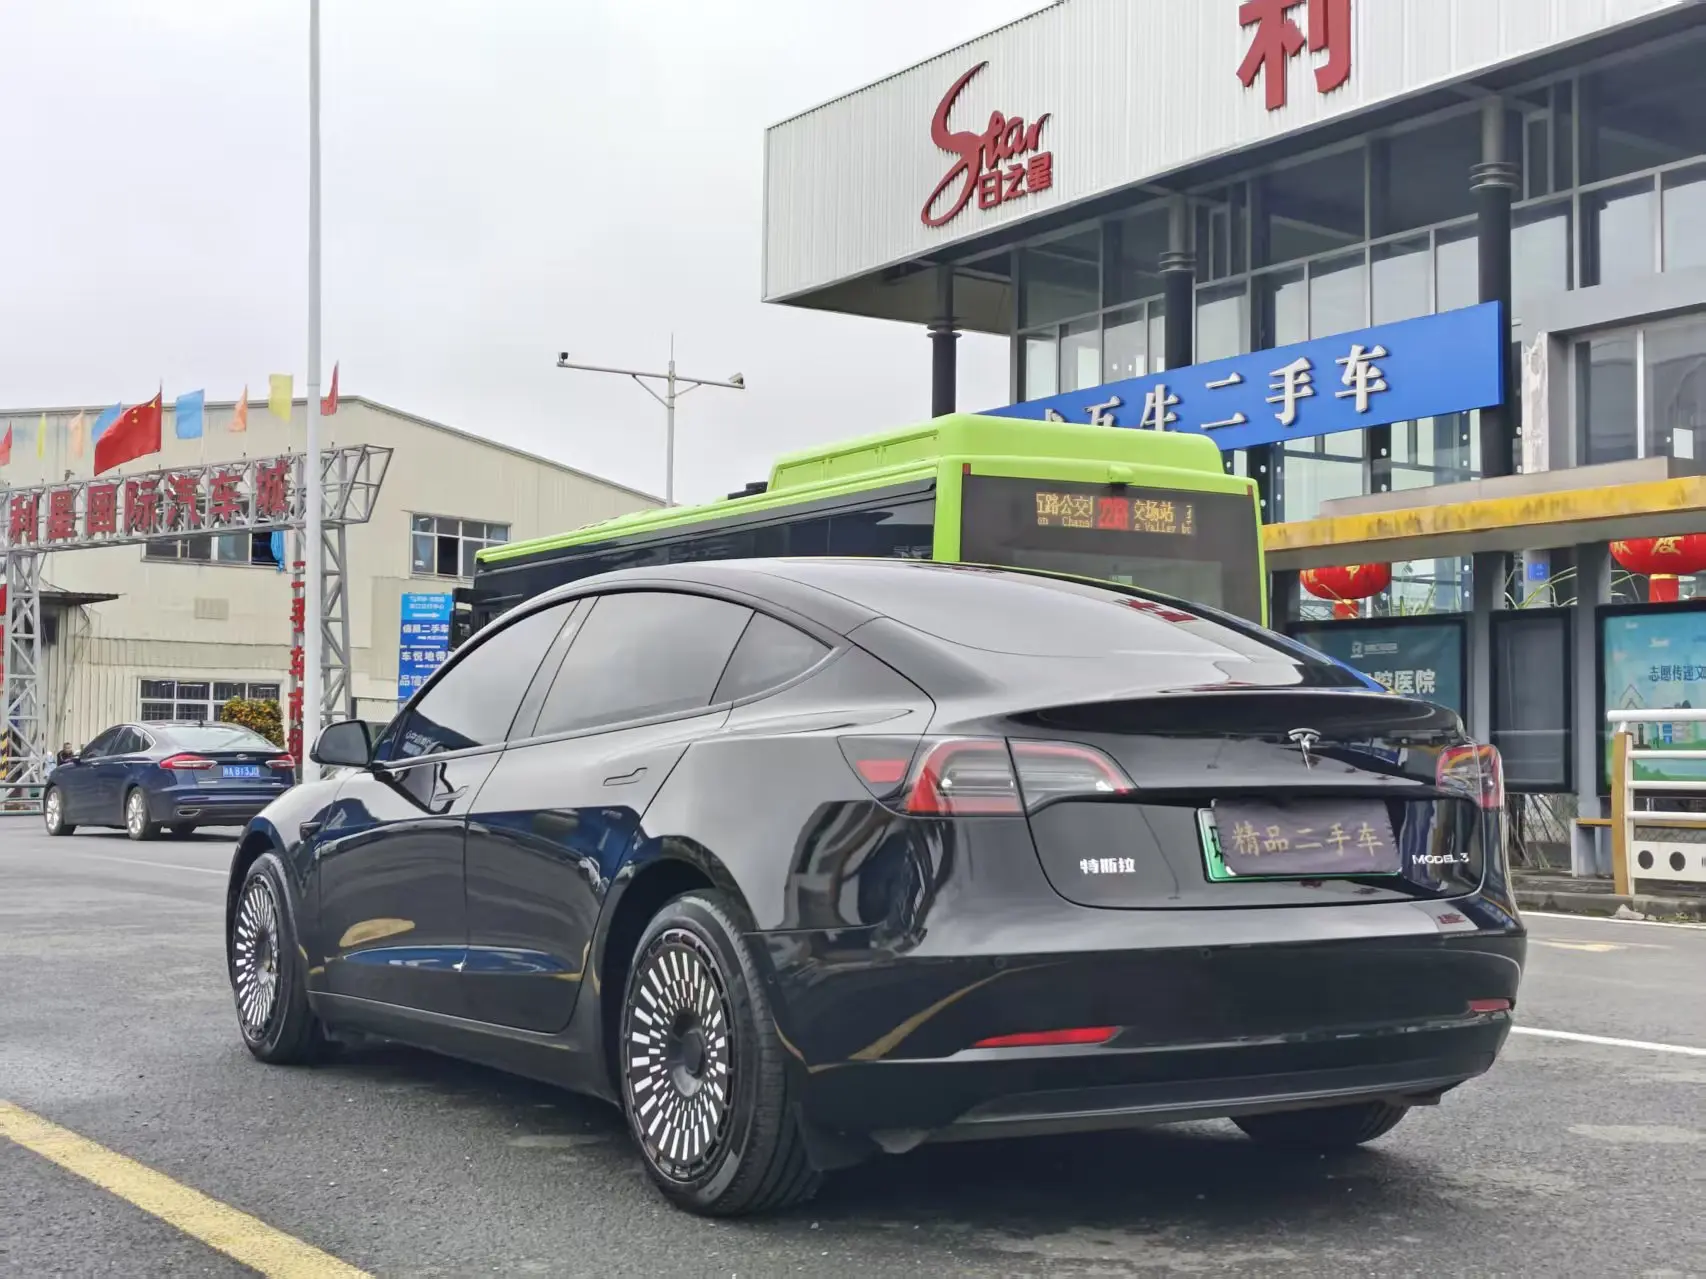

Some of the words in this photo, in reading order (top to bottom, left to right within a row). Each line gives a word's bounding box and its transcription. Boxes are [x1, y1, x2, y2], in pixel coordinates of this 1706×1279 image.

[1237, 0, 1351, 111] 利
[921, 60, 1052, 227] Star
[978, 151, 1053, 210] 日之星
[8, 454, 291, 544] 利星国际汽车城
[1365, 668, 1436, 694] 腔医院
[1231, 820, 1384, 858] 精品二手车
[1411, 854, 1459, 865] MODEL
[1459, 852, 1470, 863] 3
[1080, 857, 1136, 875] 特斯拉
